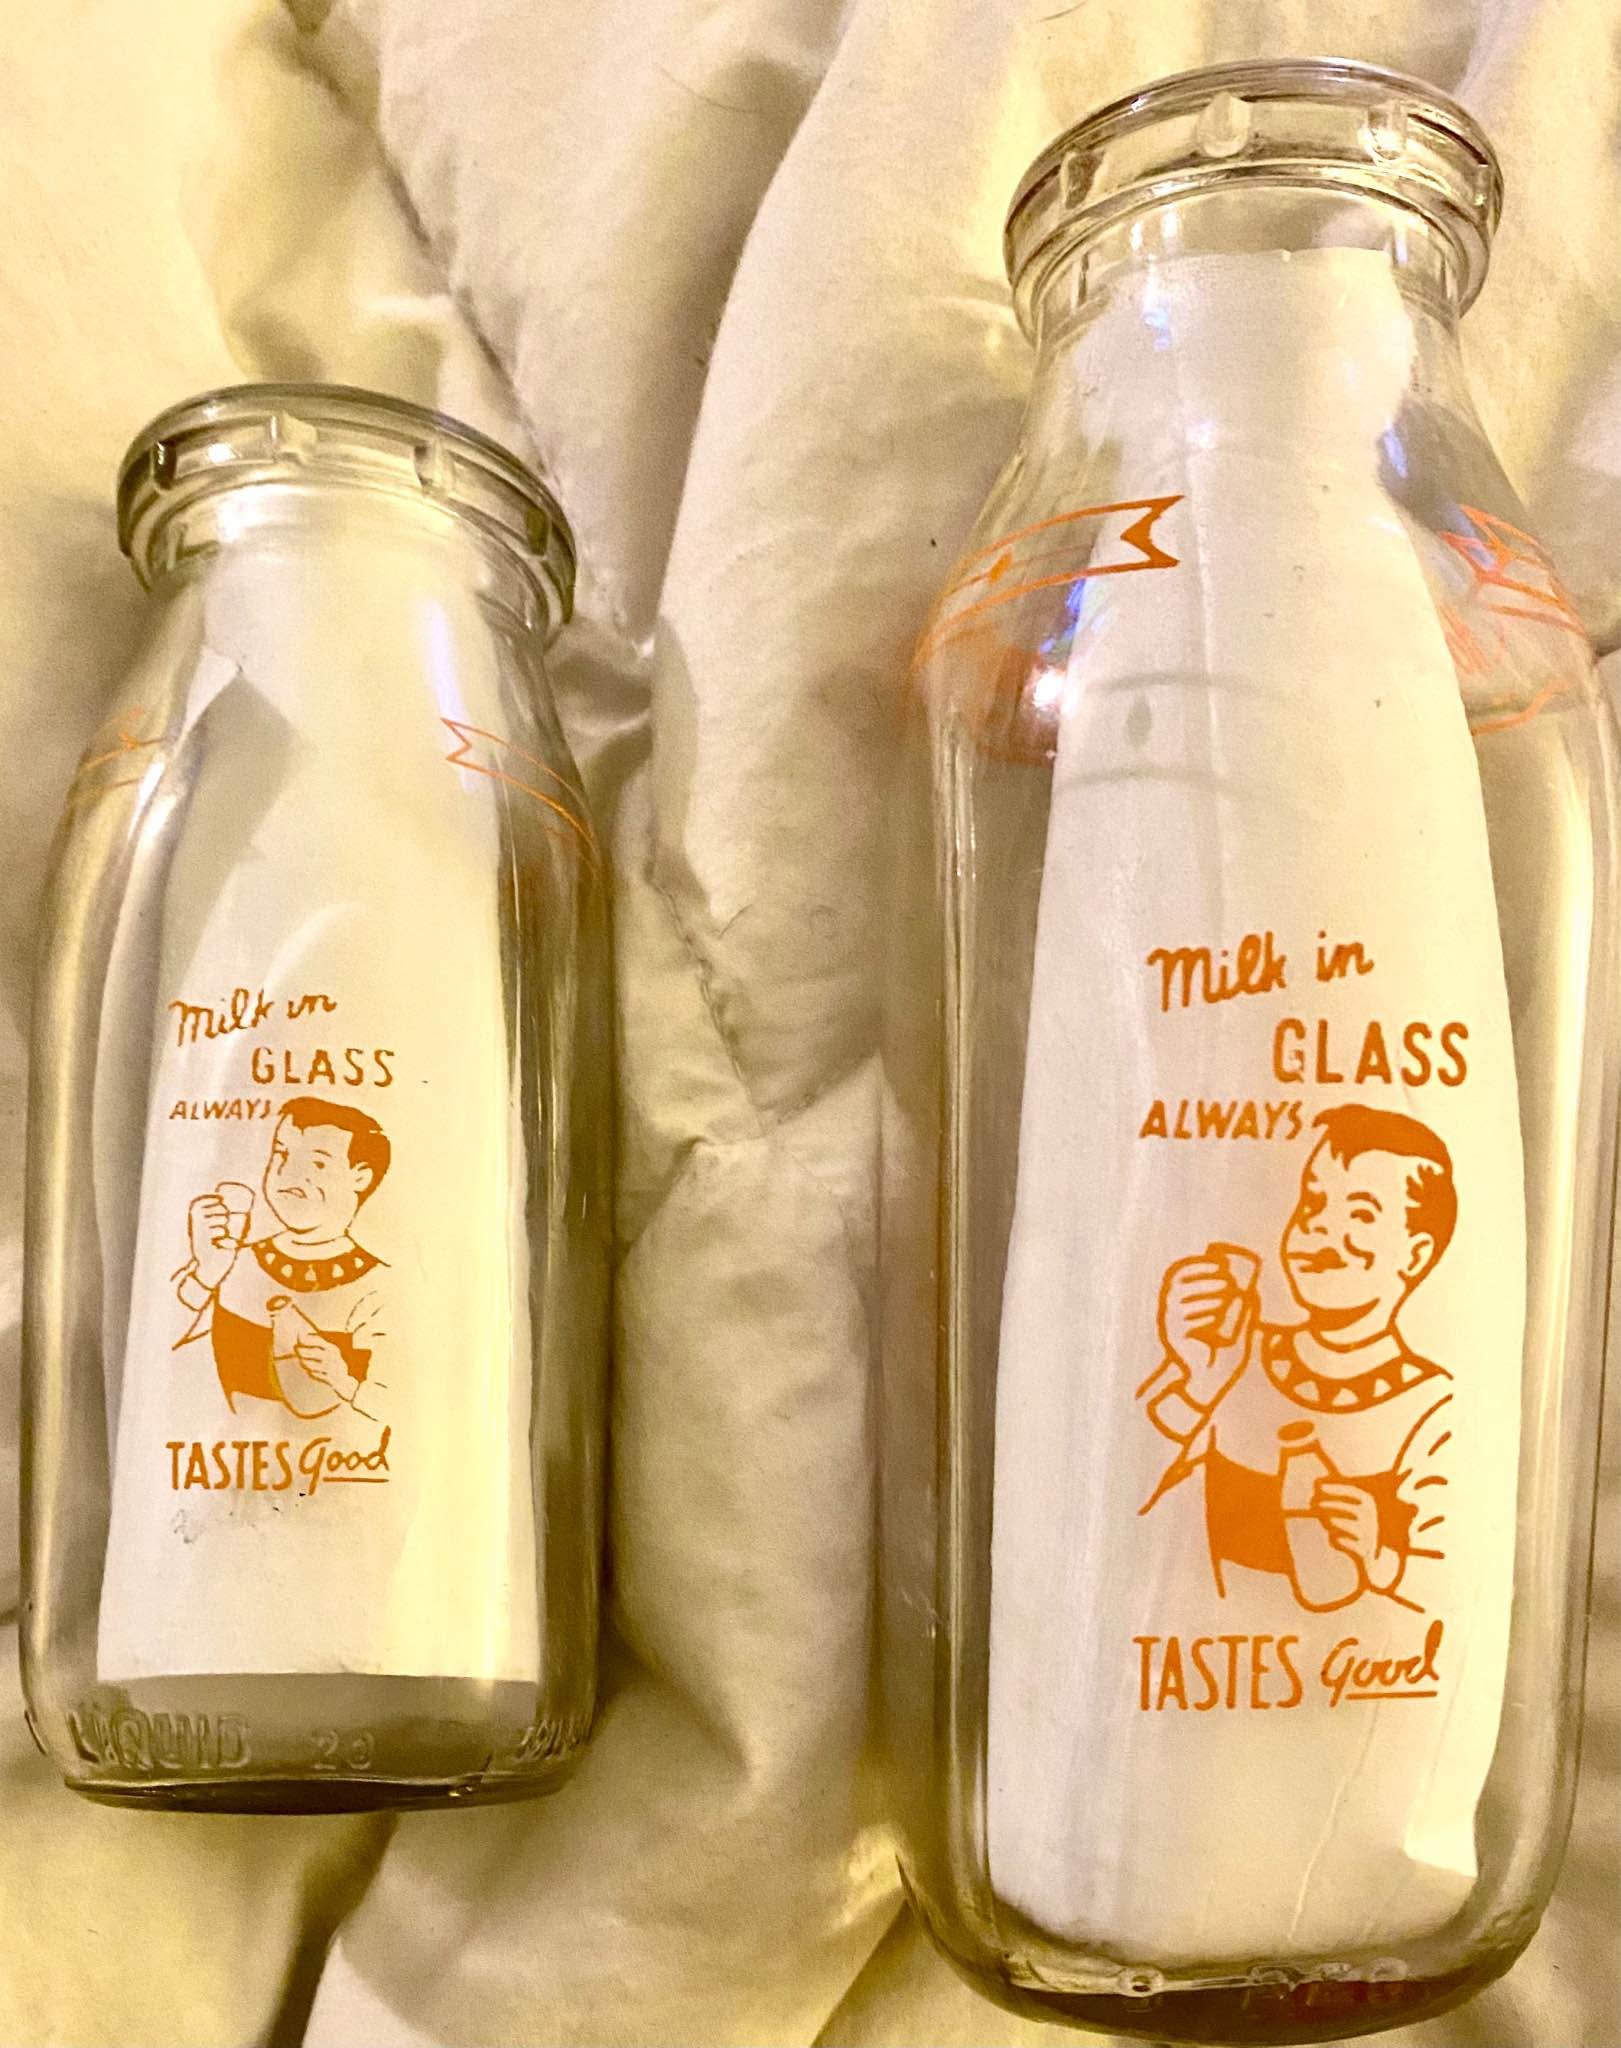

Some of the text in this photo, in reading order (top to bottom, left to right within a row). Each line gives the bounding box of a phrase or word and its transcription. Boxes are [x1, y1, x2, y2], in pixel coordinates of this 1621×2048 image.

[1146, 930, 1375, 1012] Milk in
[169, 988, 337, 1047] Milk in
[252, 1047, 395, 1087] GLASS
[1273, 1018, 1469, 1087] GLASS
[170, 1098, 271, 1120] ALWAYS
[1139, 1099, 1302, 1140] ALWAYS
[166, 1425, 392, 1496] TASTES Good
[1132, 1619, 1444, 1712] TASTES Good
